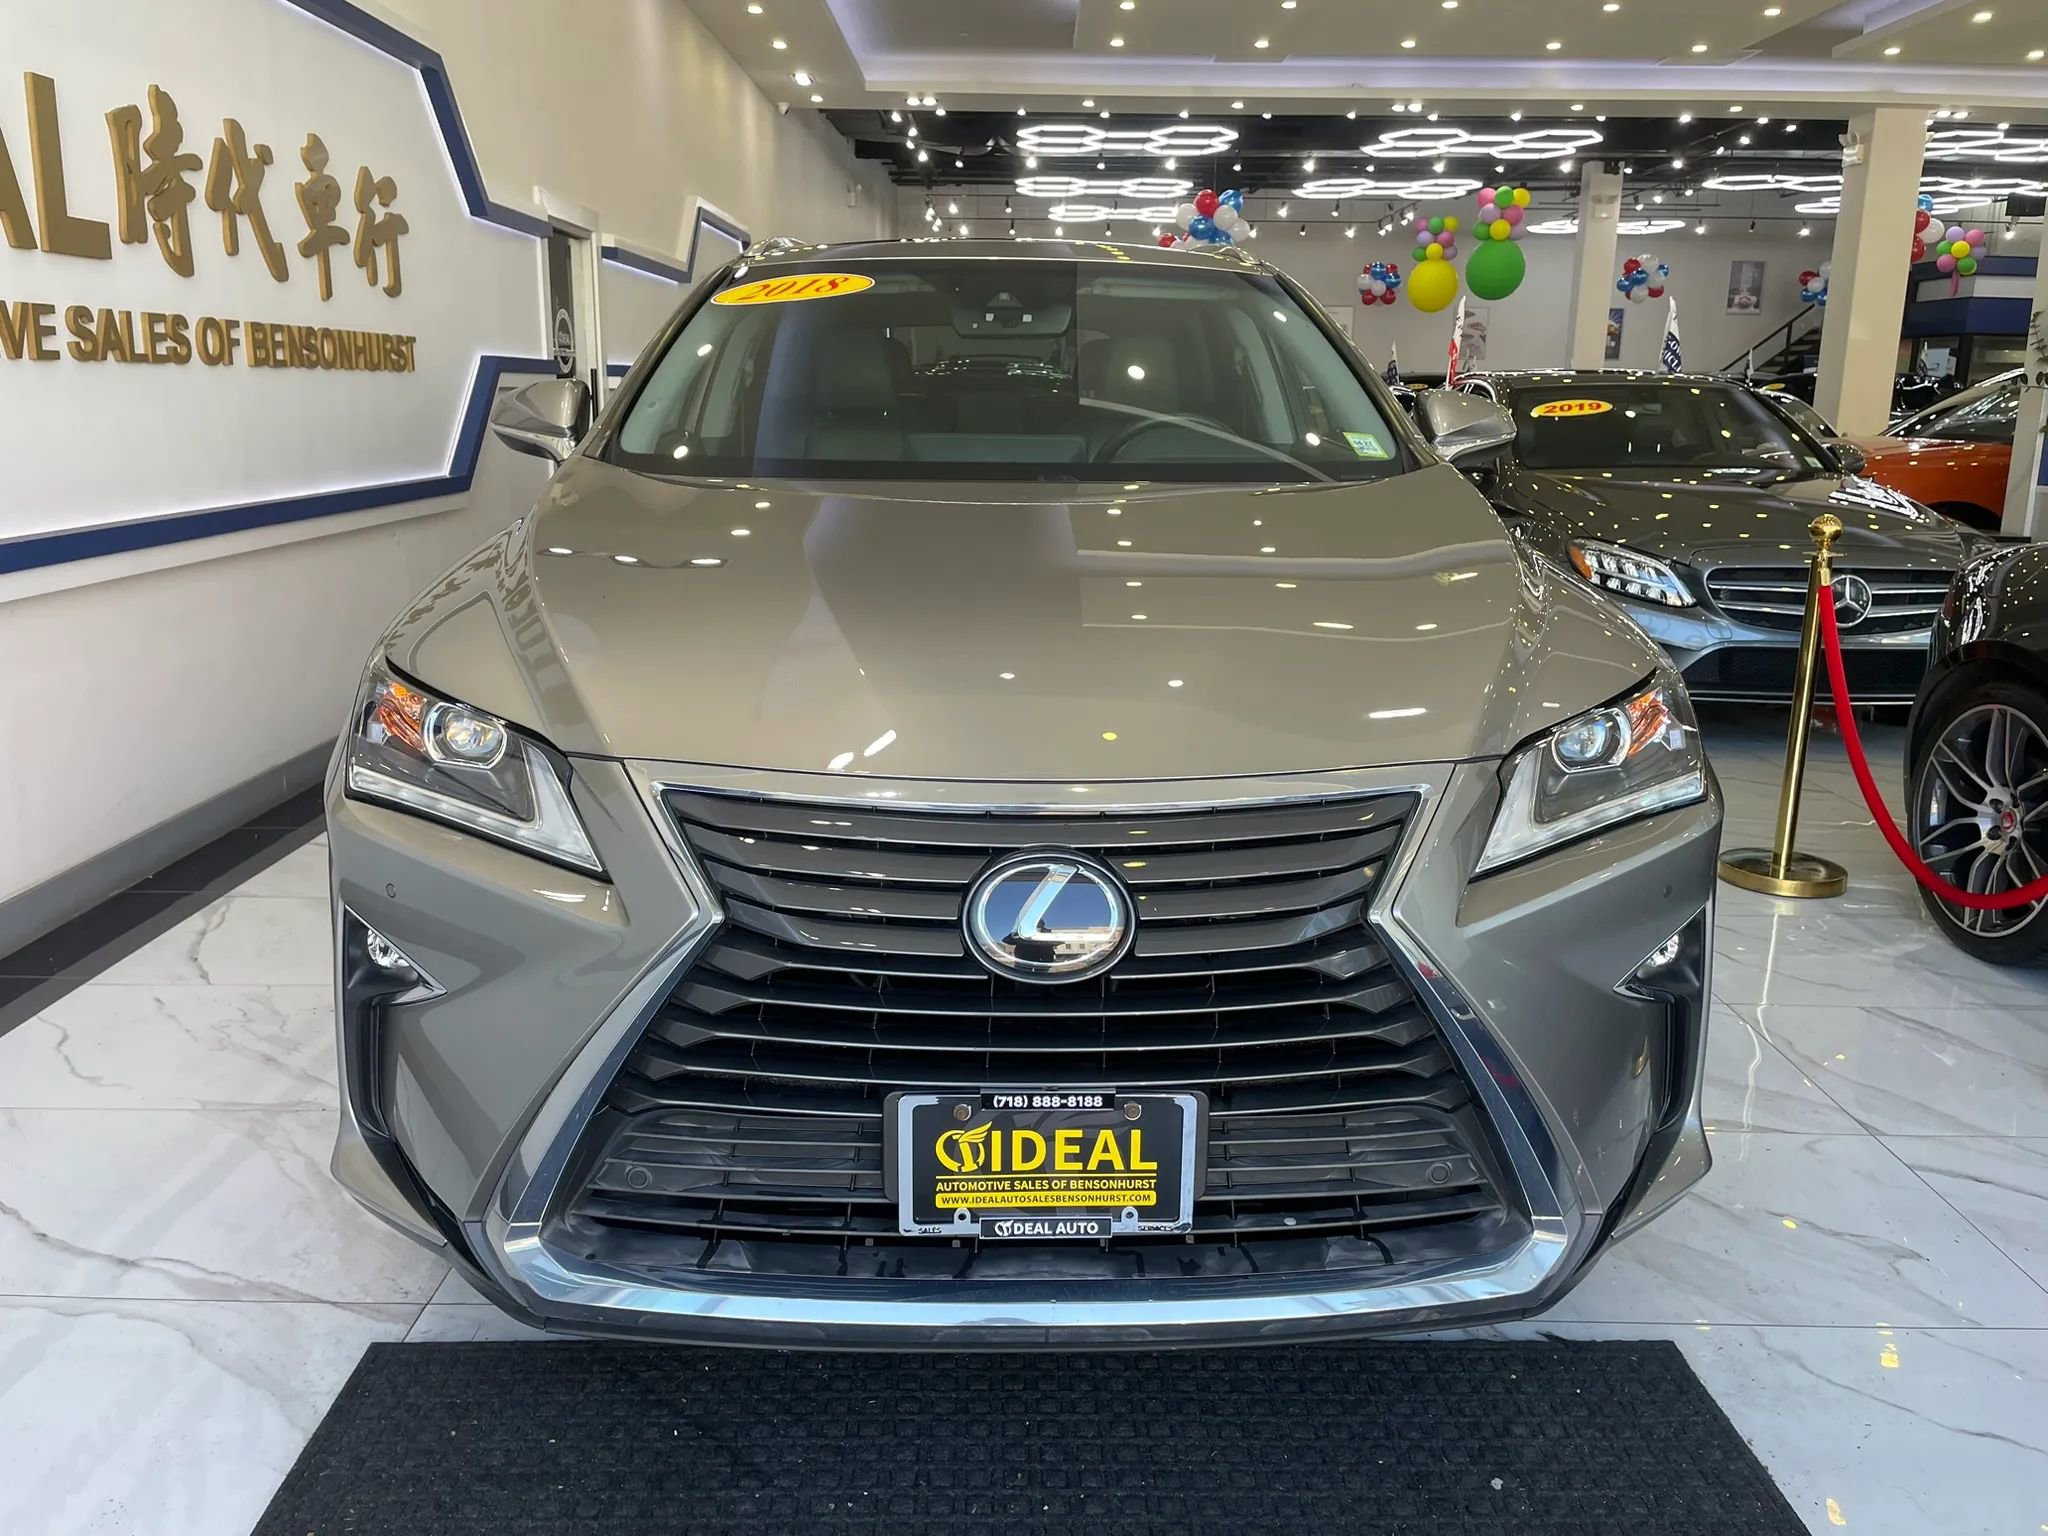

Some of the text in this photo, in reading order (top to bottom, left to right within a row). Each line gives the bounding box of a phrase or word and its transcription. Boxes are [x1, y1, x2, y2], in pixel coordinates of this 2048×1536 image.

[736, 277, 849, 301] 2018
[65, 305, 192, 364] SALES
[195, 317, 240, 366] OF
[244, 321, 416, 373] BENSONHURST
[1543, 402, 1602, 414] 2019
[993, 1095, 1103, 1108] (718) 888-8188
[991, 1129, 1158, 1172] IDEAL
[936, 1179, 1157, 1192] AUTOMOTIVE SALES OF BENSONHURST
[941, 1194, 1151, 1205] WWW.IDEALAUTOSALESBENSONHURST.COM
[1055, 1222, 1099, 1234] AUTO
